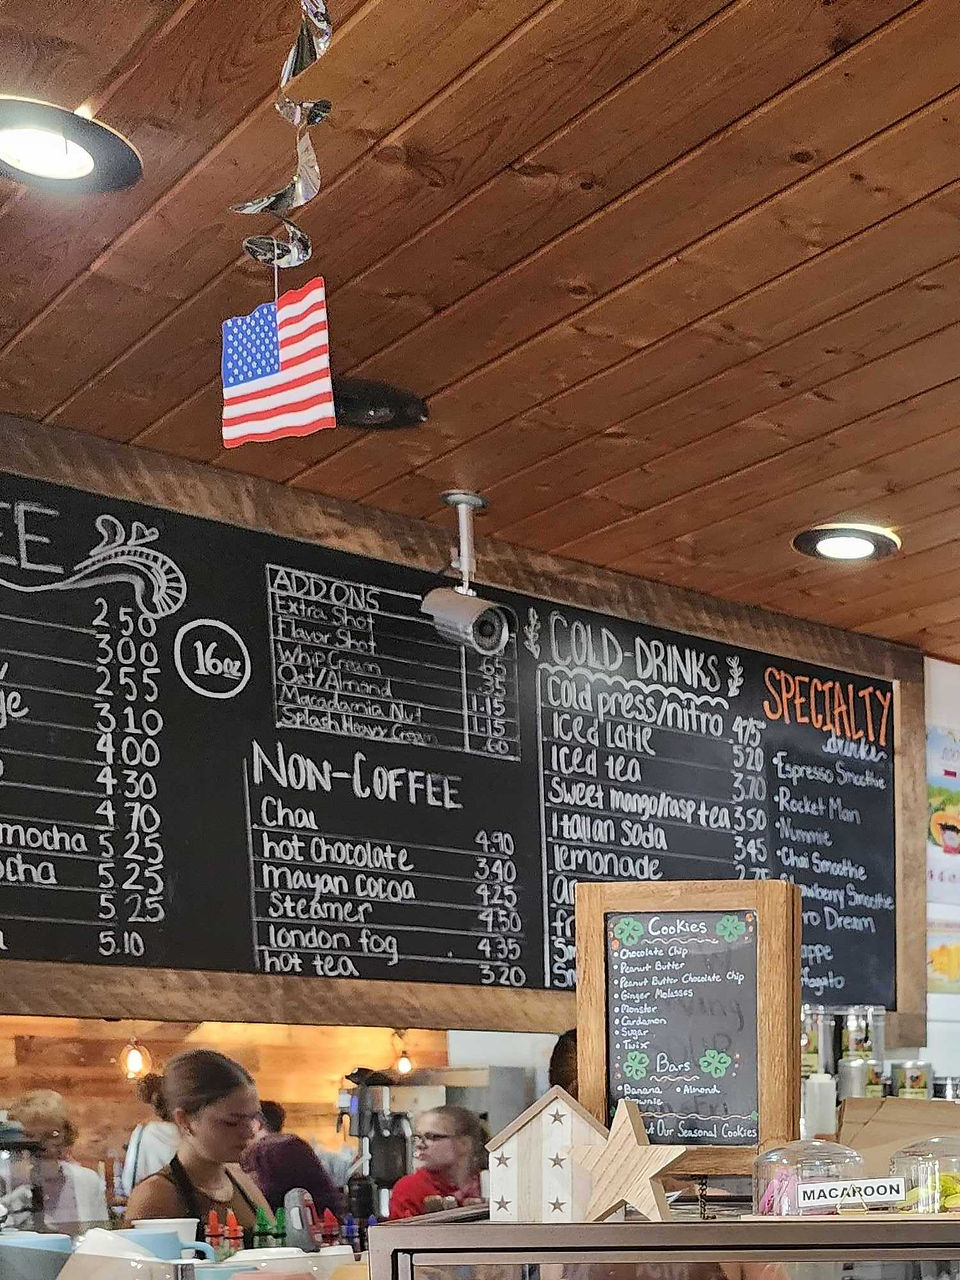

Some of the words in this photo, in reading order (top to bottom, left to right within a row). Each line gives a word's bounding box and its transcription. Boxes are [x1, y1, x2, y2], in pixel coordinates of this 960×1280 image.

[273, 569, 327, 599] ADD
[329, 583, 381, 612] ONS
[275, 593, 328, 620] Extra
[332, 606, 376, 631] Shot
[278, 616, 330, 643] Flavor
[547, 676, 593, 711] Cold
[598, 691, 723, 737] press/nitro
[763, 666, 891, 747] SPECIALTY
[553, 711, 599, 747] Iced
[551, 745, 597, 777] Iced
[605, 755, 642, 783] tea
[776, 751, 834, 786] Espresso
[835, 760, 887, 790] Smoothie
[261, 796, 318, 830] Chai
[548, 776, 604, 810] Sweet
[697, 802, 731, 828] tea
[778, 785, 827, 816] Rocket
[828, 796, 862, 825] Man
[262, 831, 305, 861] hot
[554, 844, 663, 880] lemonade
[779, 846, 810, 869] Chai
[811, 851, 868, 881] Smoothie
[262, 863, 349, 903] mayan
[268, 892, 373, 922] Steamer
[823, 905, 876, 934] Dream
[98, 930, 145, 957] 5.10
[268, 923, 351, 949] london
[360, 928, 399, 966] fog
[619, 948, 664, 959] Chocolate
[668, 946, 689, 958] Chip
[264, 949, 303, 973] hot
[312, 954, 360, 977] tea
[619, 962, 652, 973] Peanut
[654, 961, 685, 971] Butter
[619, 977, 649, 989] Peanut
[651, 977, 679, 986] Butter
[681, 973, 722, 984] Chocolate
[726, 971, 745, 985] Chip
[620, 990, 651, 1003] Ginger
[654, 988, 694, 999] Molasses
[620, 1004, 658, 1014] Monster
[621, 1027, 649, 1039] Sugar
[622, 1039, 650, 1050] Twix
[656, 1052, 692, 1073] Bars
[623, 1083, 663, 1095] Banana
[683, 1083, 721, 1094] Almond
[656, 1119, 675, 1137] Our
[677, 1120, 718, 1138] Seasonal
[721, 1123, 758, 1138] Cookies
[802, 1183, 901, 1202] MACAROON
